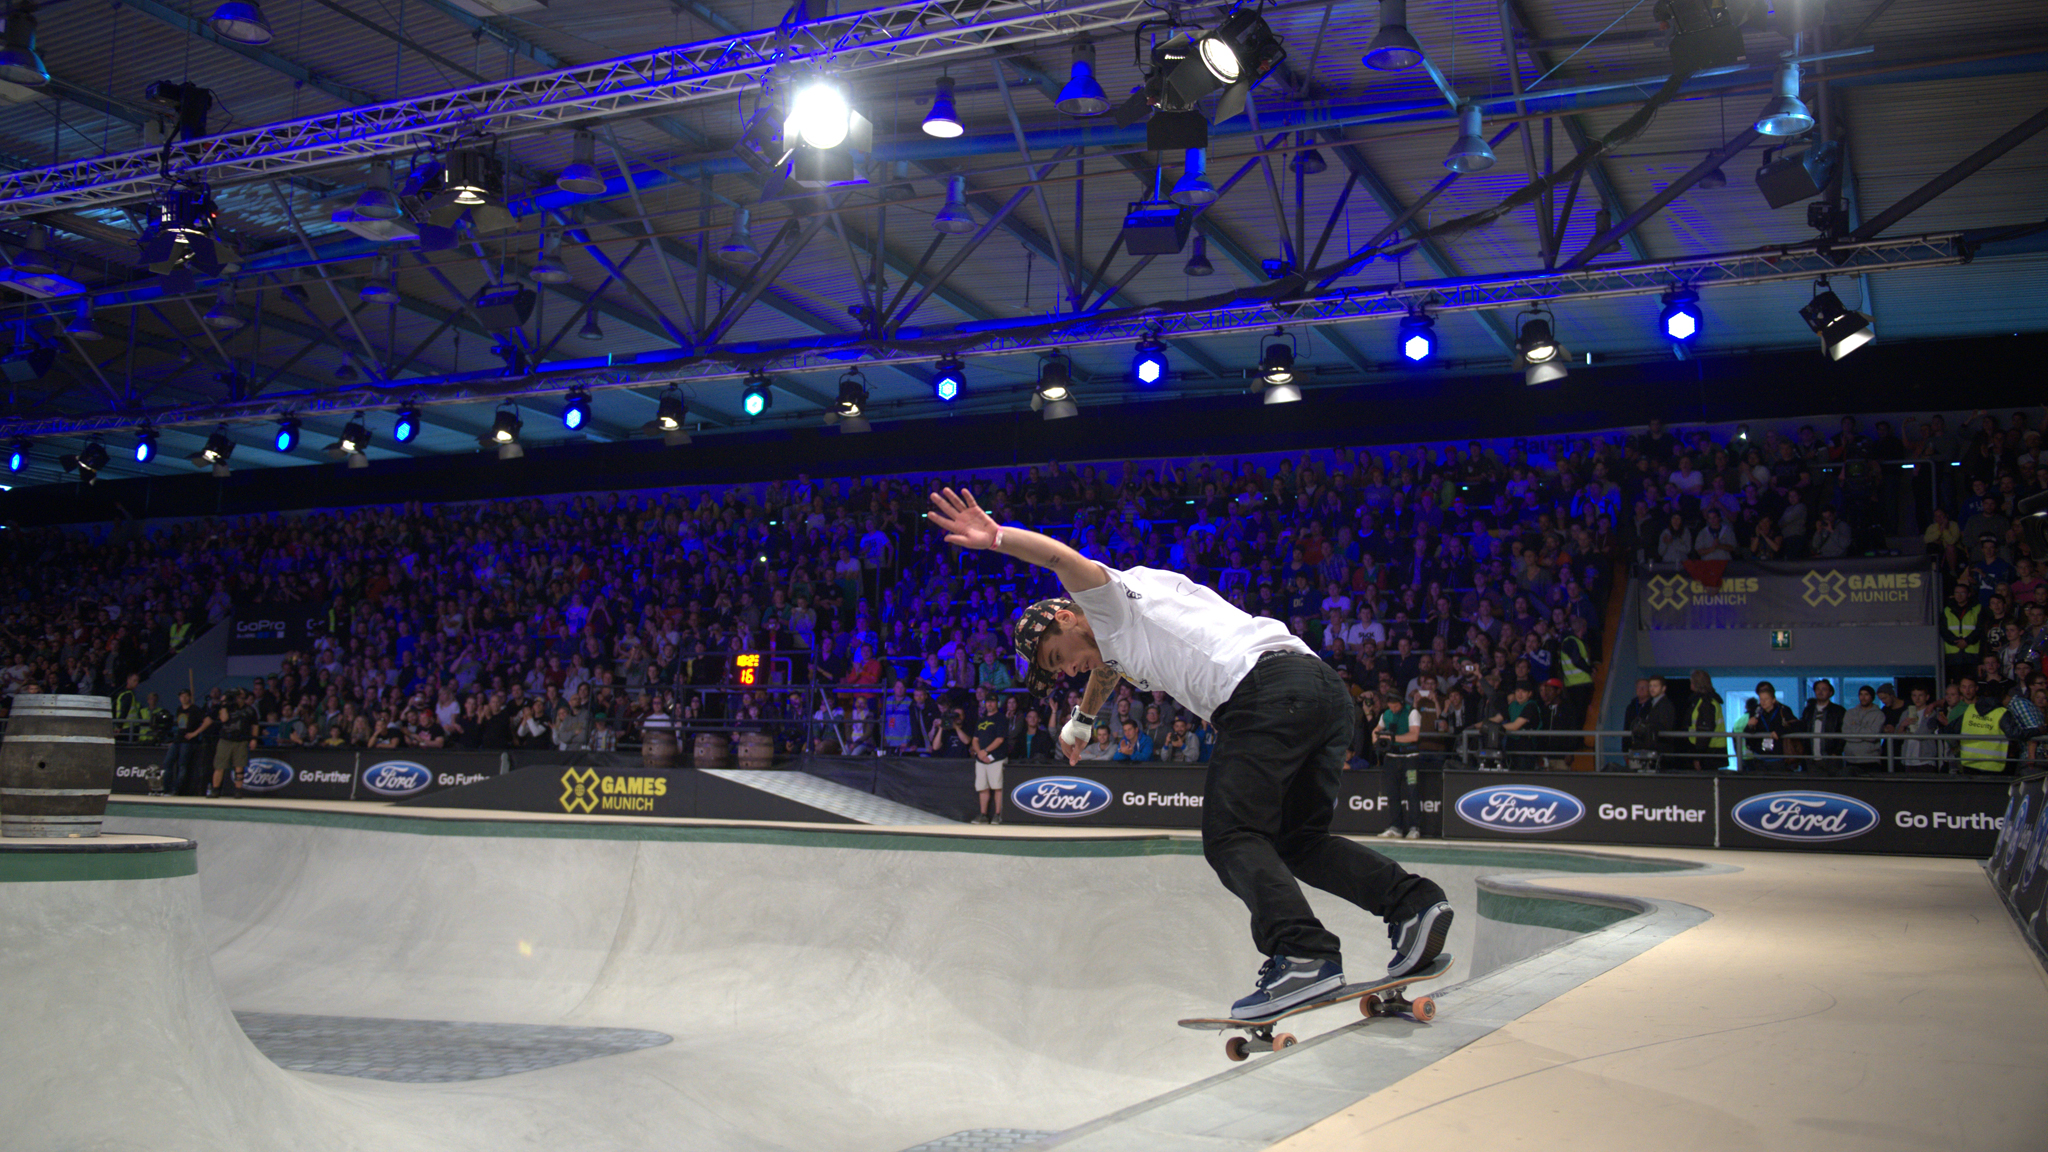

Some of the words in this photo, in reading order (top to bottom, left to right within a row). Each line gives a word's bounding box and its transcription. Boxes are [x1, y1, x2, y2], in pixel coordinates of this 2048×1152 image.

[1690, 577, 1759, 594] GMES
[1848, 573, 1921, 590] GAMES
[1692, 594, 1747, 606] MUNICH
[1850, 590, 1908, 603] MUNICH
[236, 620, 286, 632] GoPro
[740, 668, 755, 685] 16
[1968, 719, 1994, 731] Security
[116, 765, 131, 777] Go
[243, 762, 282, 785] Ford
[299, 770, 314, 783] Go
[314, 770, 351, 783] Further
[374, 766, 418, 789] Ford
[438, 773, 455, 786] Go
[601, 775, 667, 796] GAMES
[602, 796, 654, 811] MUNICH
[1030, 782, 1092, 810] Ford
[1122, 791, 1145, 806] Go
[1347, 795, 1374, 811] Go
[1480, 791, 1559, 824] Ford
[1598, 803, 1628, 820] Go
[1631, 804, 1706, 823] Further
[1760, 798, 1849, 833] Ford
[1894, 811, 1929, 828] Go
[1932, 811, 2006, 831] Furthe
